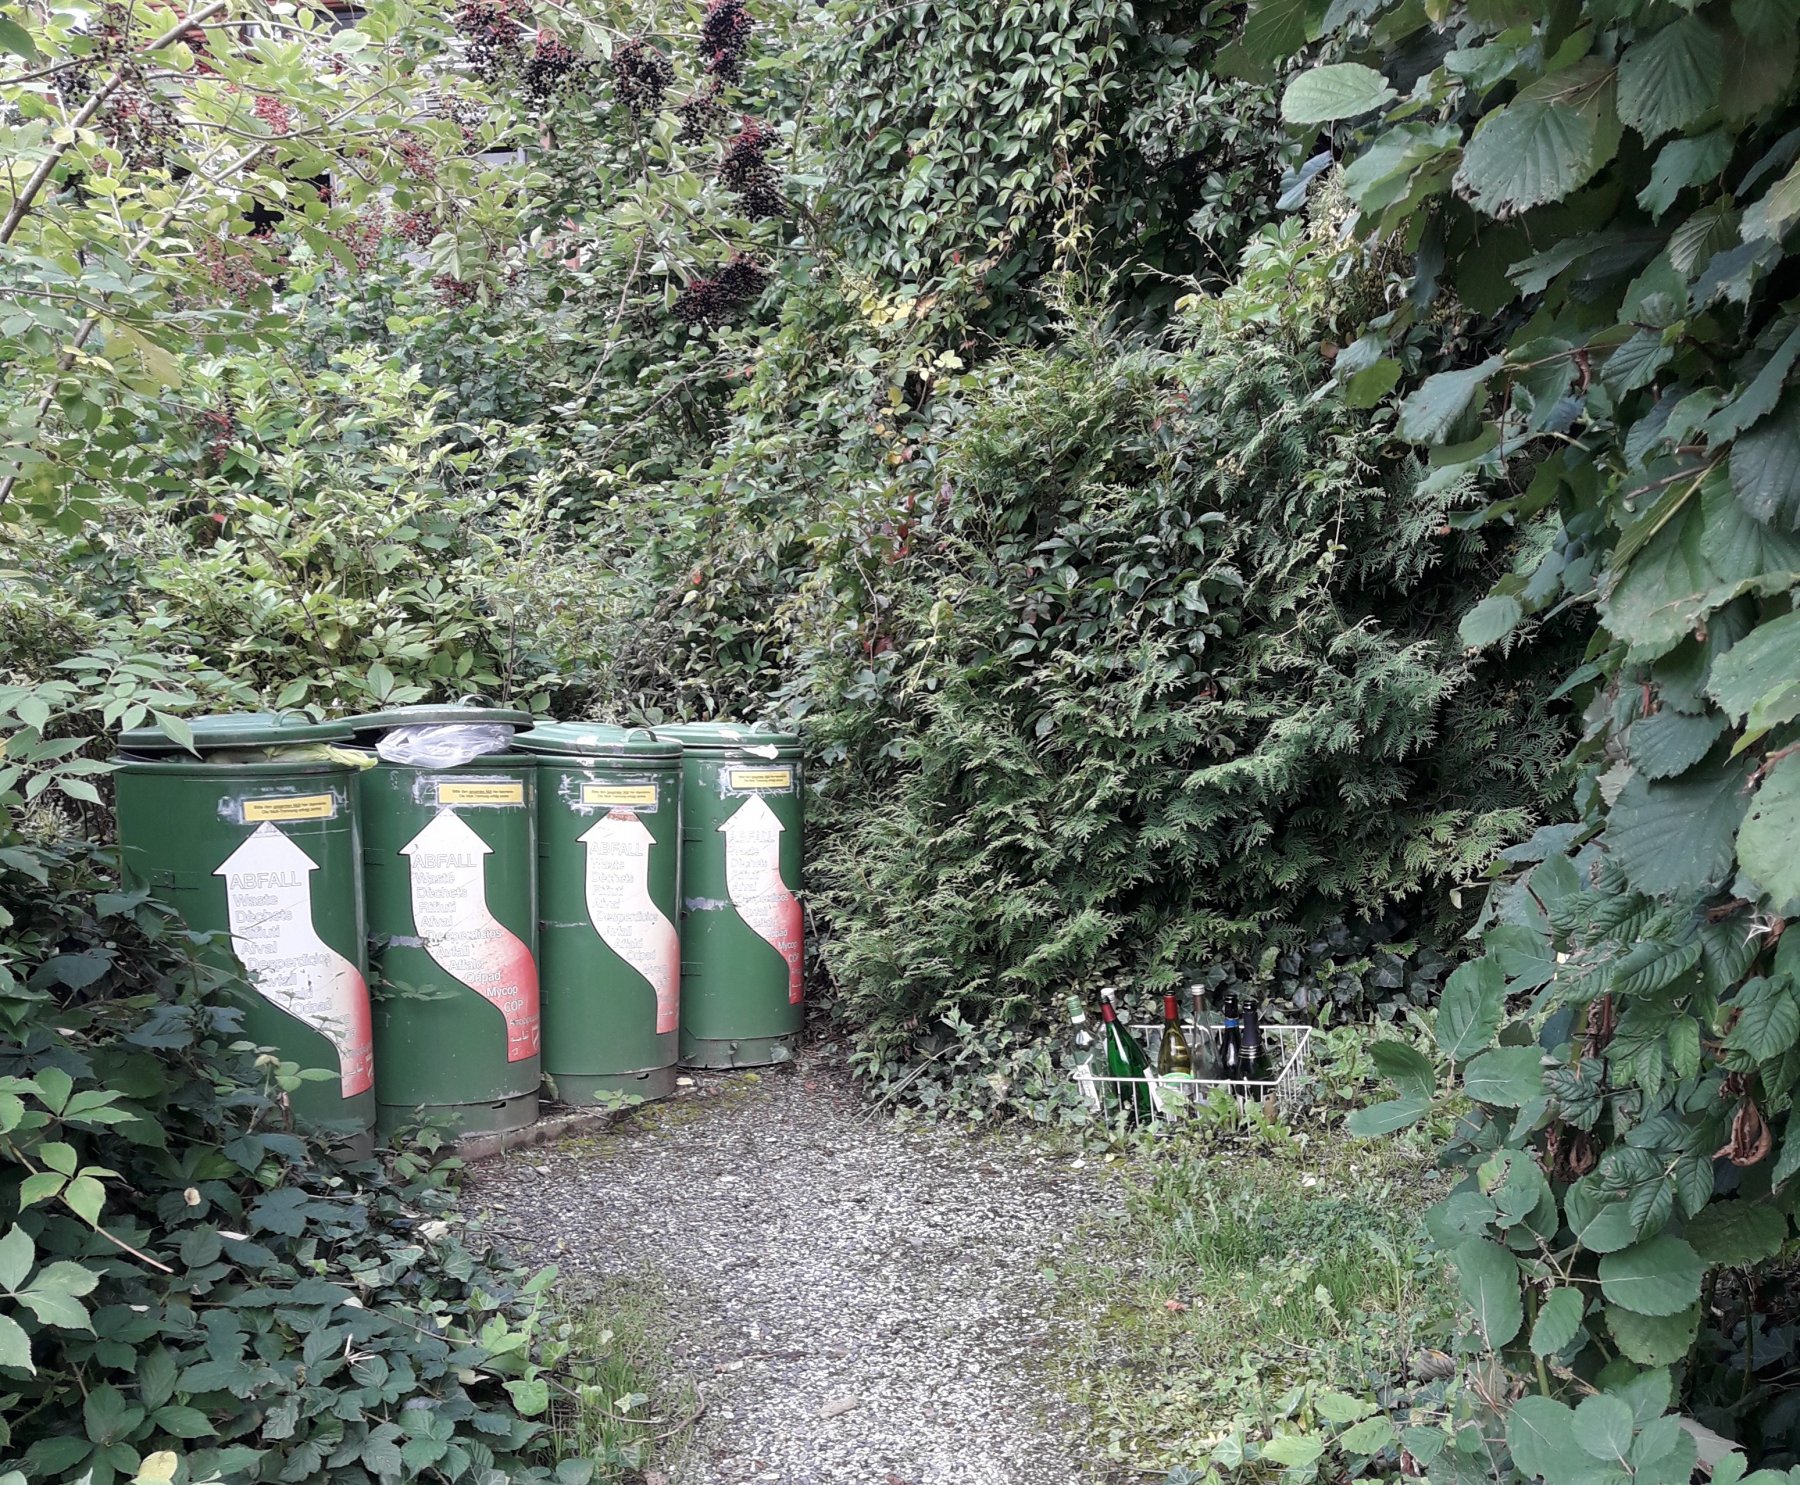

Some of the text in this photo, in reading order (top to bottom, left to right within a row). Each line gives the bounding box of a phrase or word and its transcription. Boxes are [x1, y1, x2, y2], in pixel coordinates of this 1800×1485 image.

[589, 841, 644, 857] ABFALL
[412, 853, 477, 868] ABFALL
[230, 870, 302, 889] ABFALL
[233, 893, 278, 907] Waste
